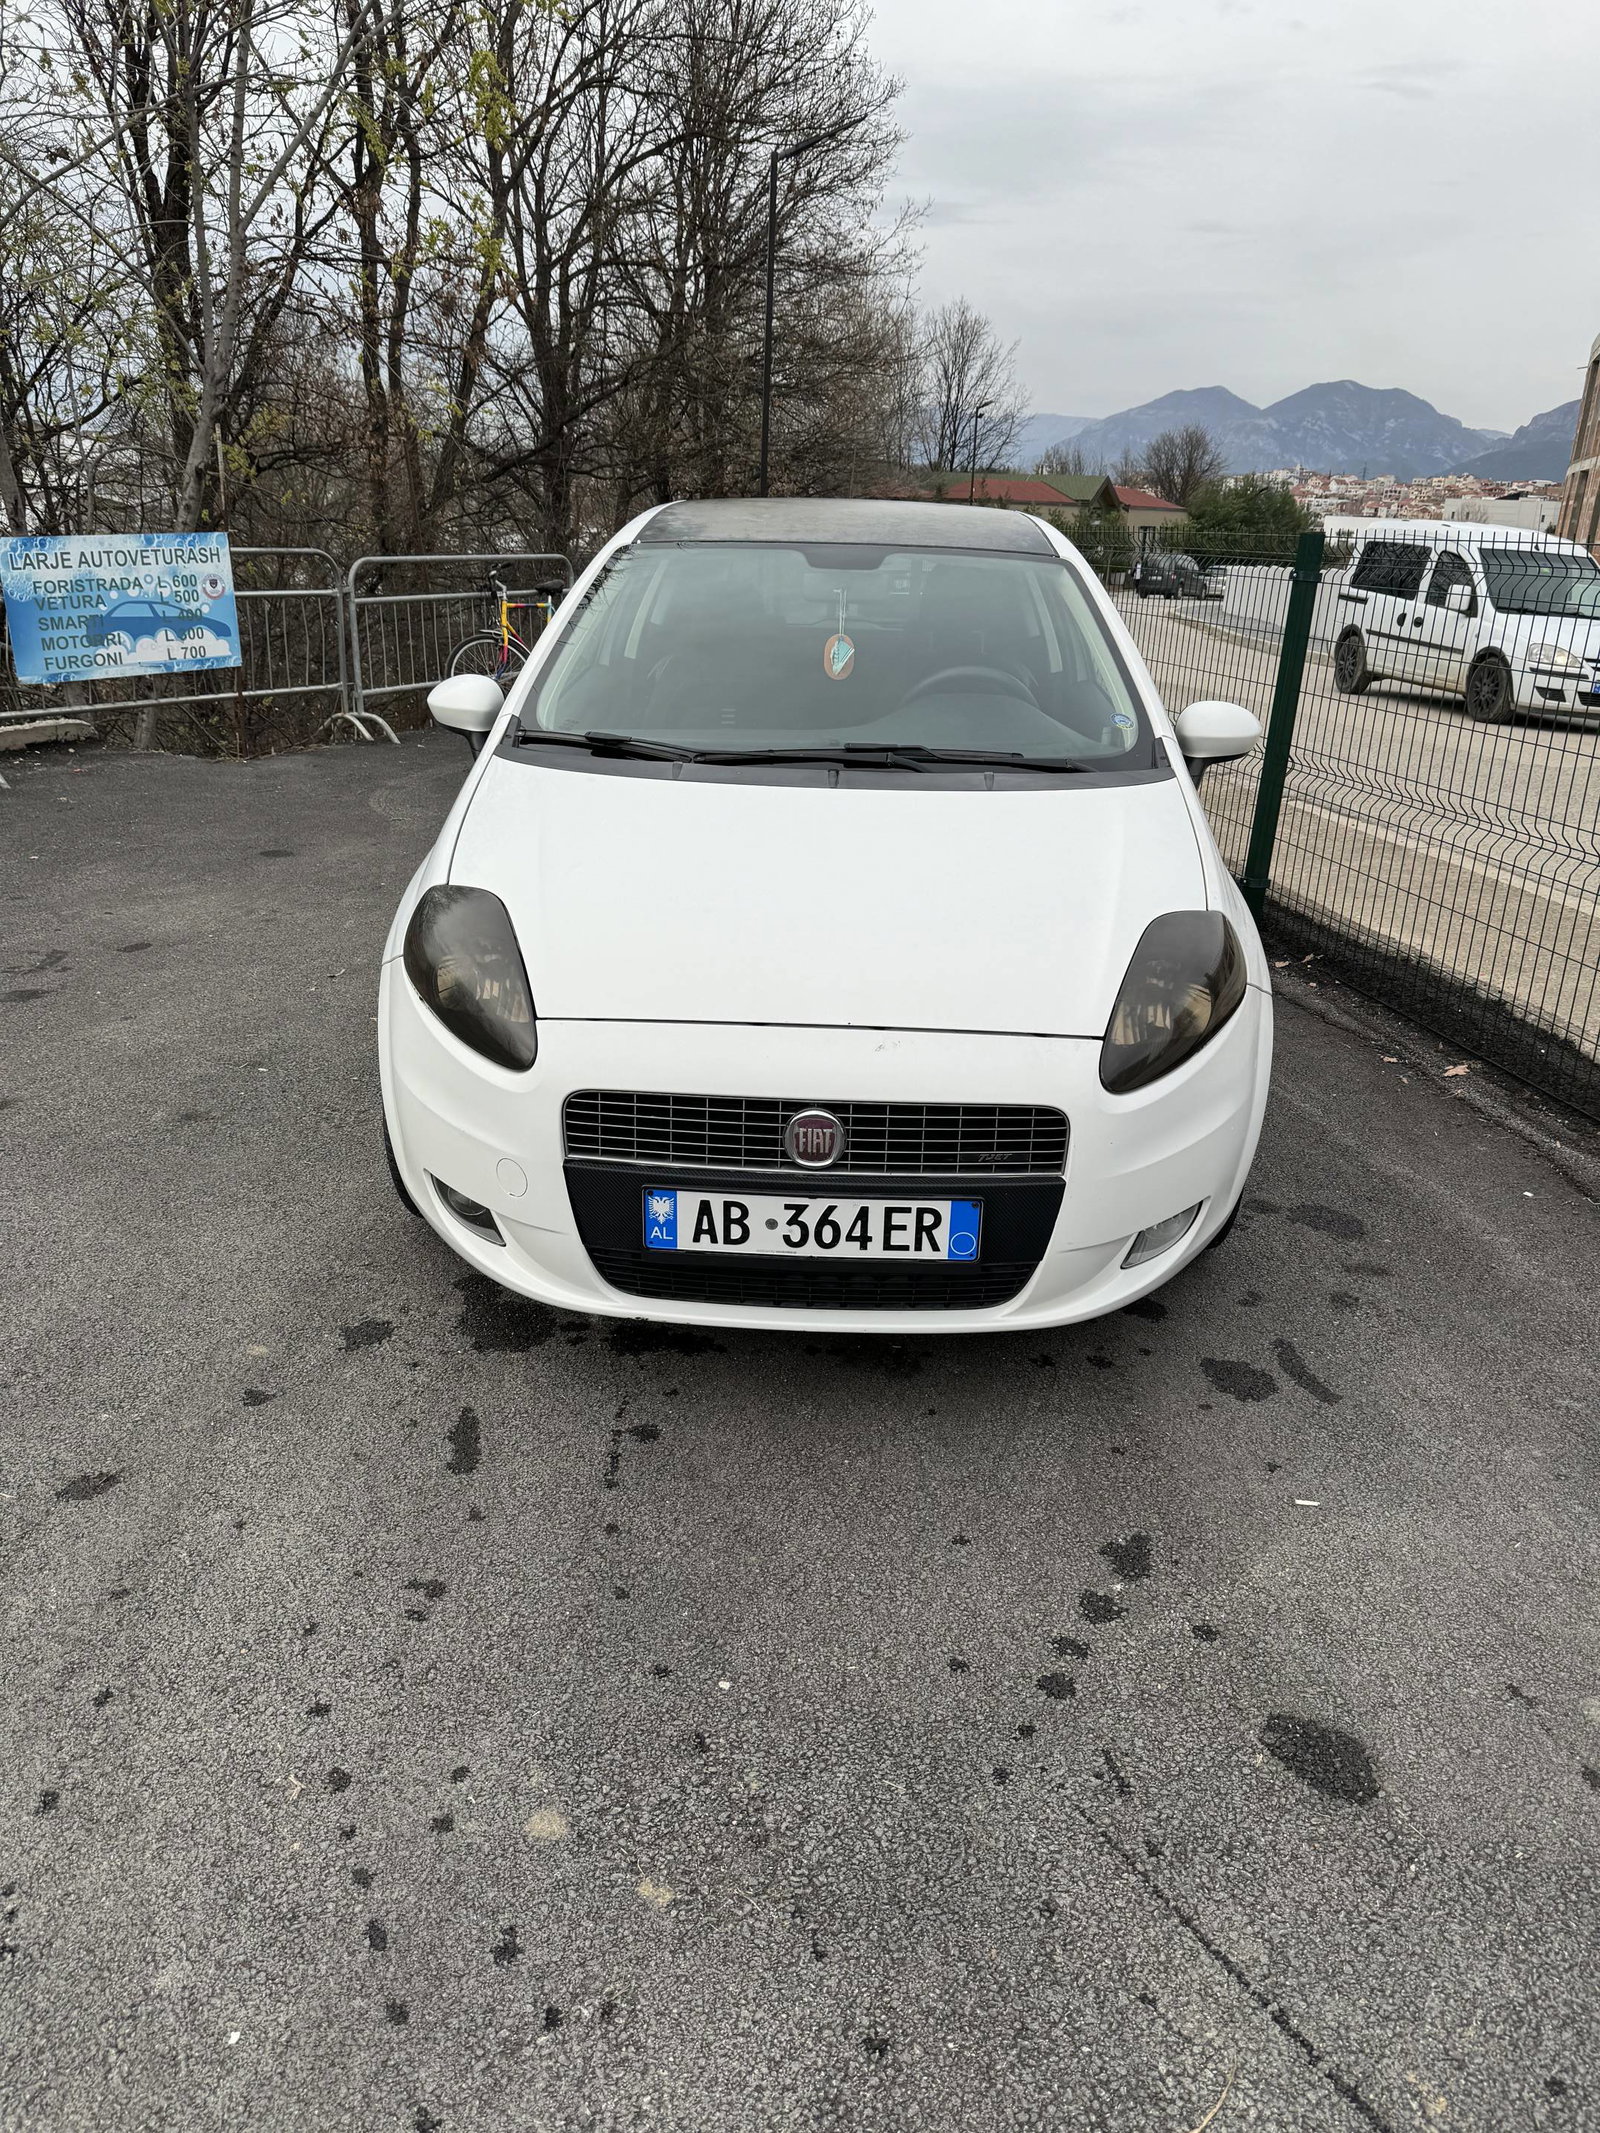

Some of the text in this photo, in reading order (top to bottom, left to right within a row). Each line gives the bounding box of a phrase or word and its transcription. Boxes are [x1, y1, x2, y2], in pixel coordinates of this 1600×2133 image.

[9, 546, 221, 571] LARJE AUTOVETURASH
[32, 576, 144, 595] FORISTRADA
[157, 575, 168, 589] L
[172, 574, 198, 588] 600
[34, 589, 200, 611] VETURA L 500
[38, 614, 104, 631] SMARTI
[178, 607, 203, 621] 400
[164, 628, 175, 642] L
[43, 645, 207, 671] FURGONI L 700
[798, 1127, 833, 1154] FIAT
[650, 1227, 674, 1241] AL
[692, 1199, 751, 1246] AB
